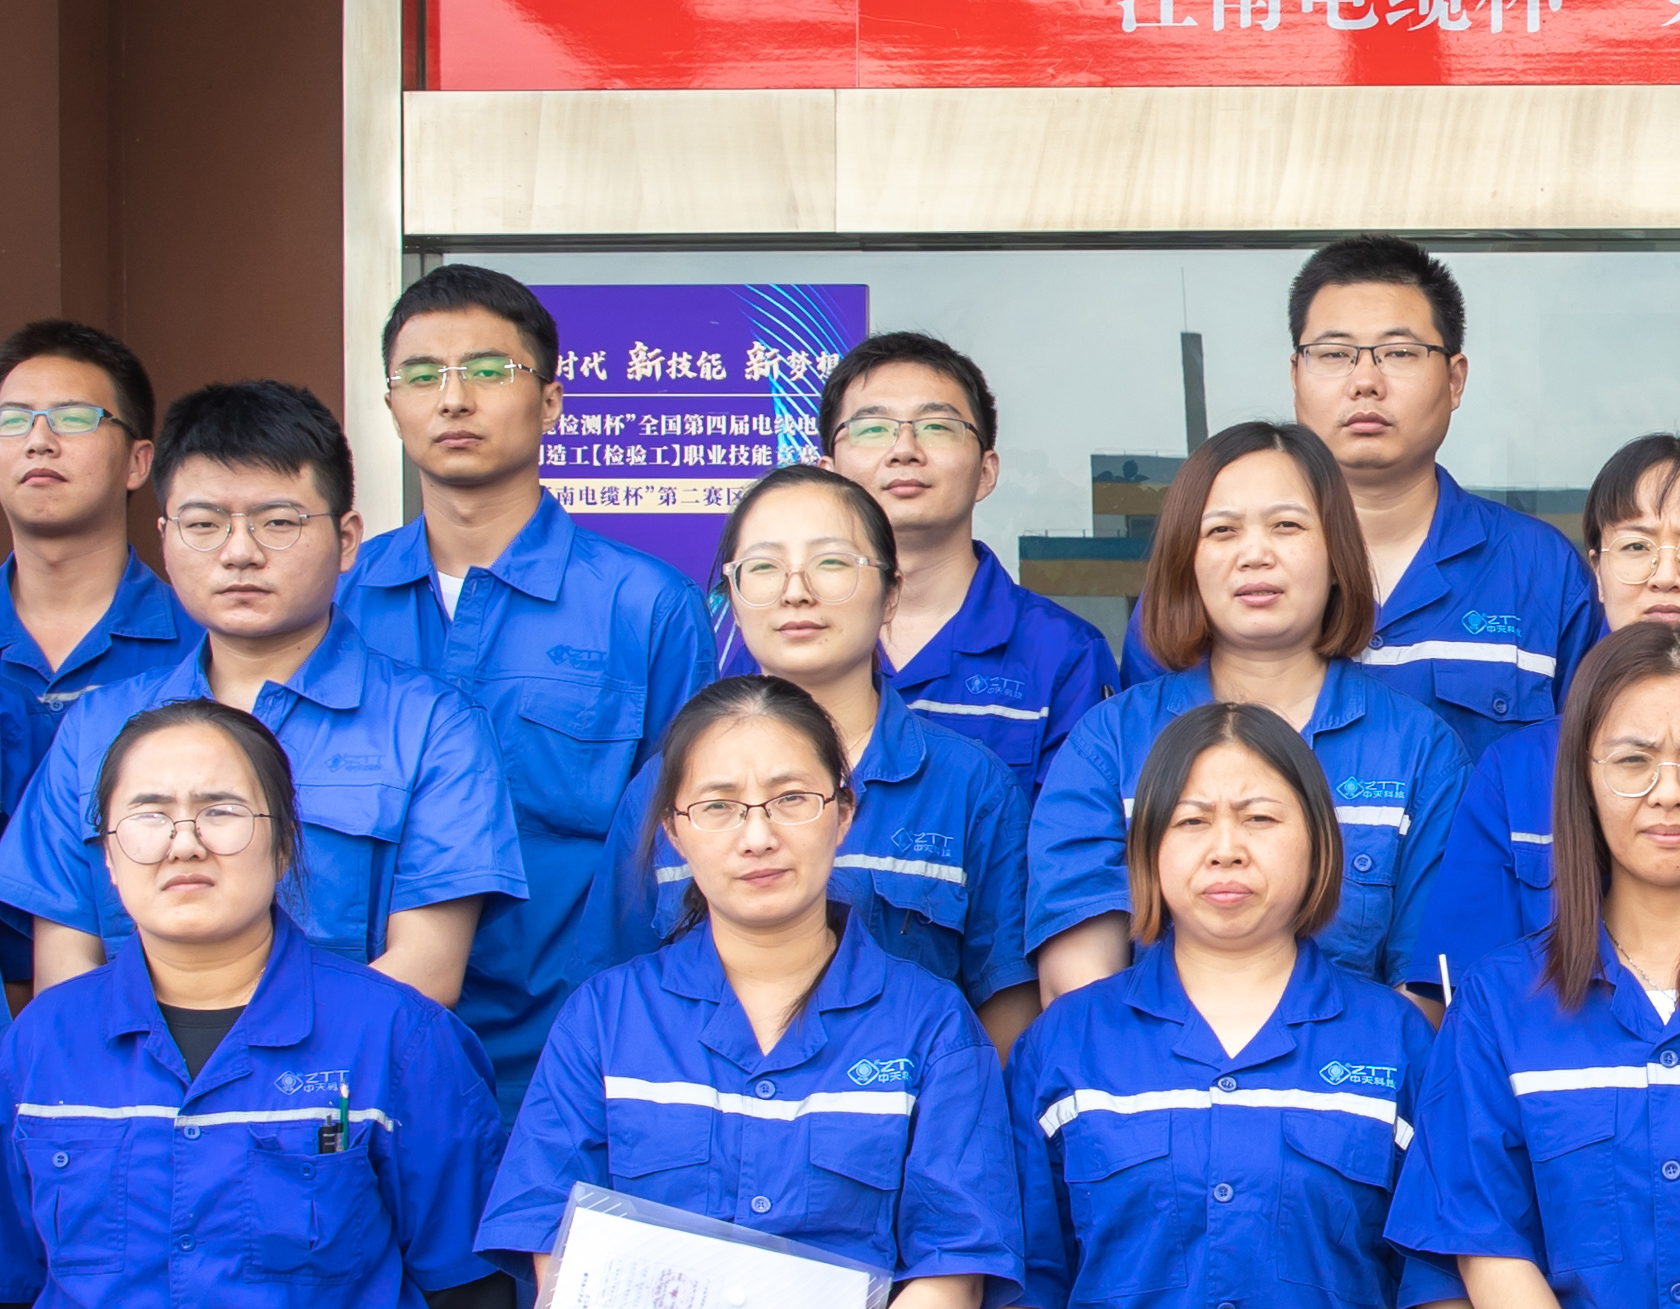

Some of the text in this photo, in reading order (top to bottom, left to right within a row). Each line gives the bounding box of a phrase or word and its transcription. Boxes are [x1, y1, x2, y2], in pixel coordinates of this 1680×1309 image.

[626, 340, 727, 382] 新技能
[542, 413, 819, 437] 检测杯”全国第四届电线电
[988, 677, 1025, 692] ZTT
[1365, 781, 1405, 792] ZTT
[914, 832, 954, 847] ZTT
[305, 1069, 350, 1083] ZTT
[1354, 1065, 1397, 1079] ZTT
